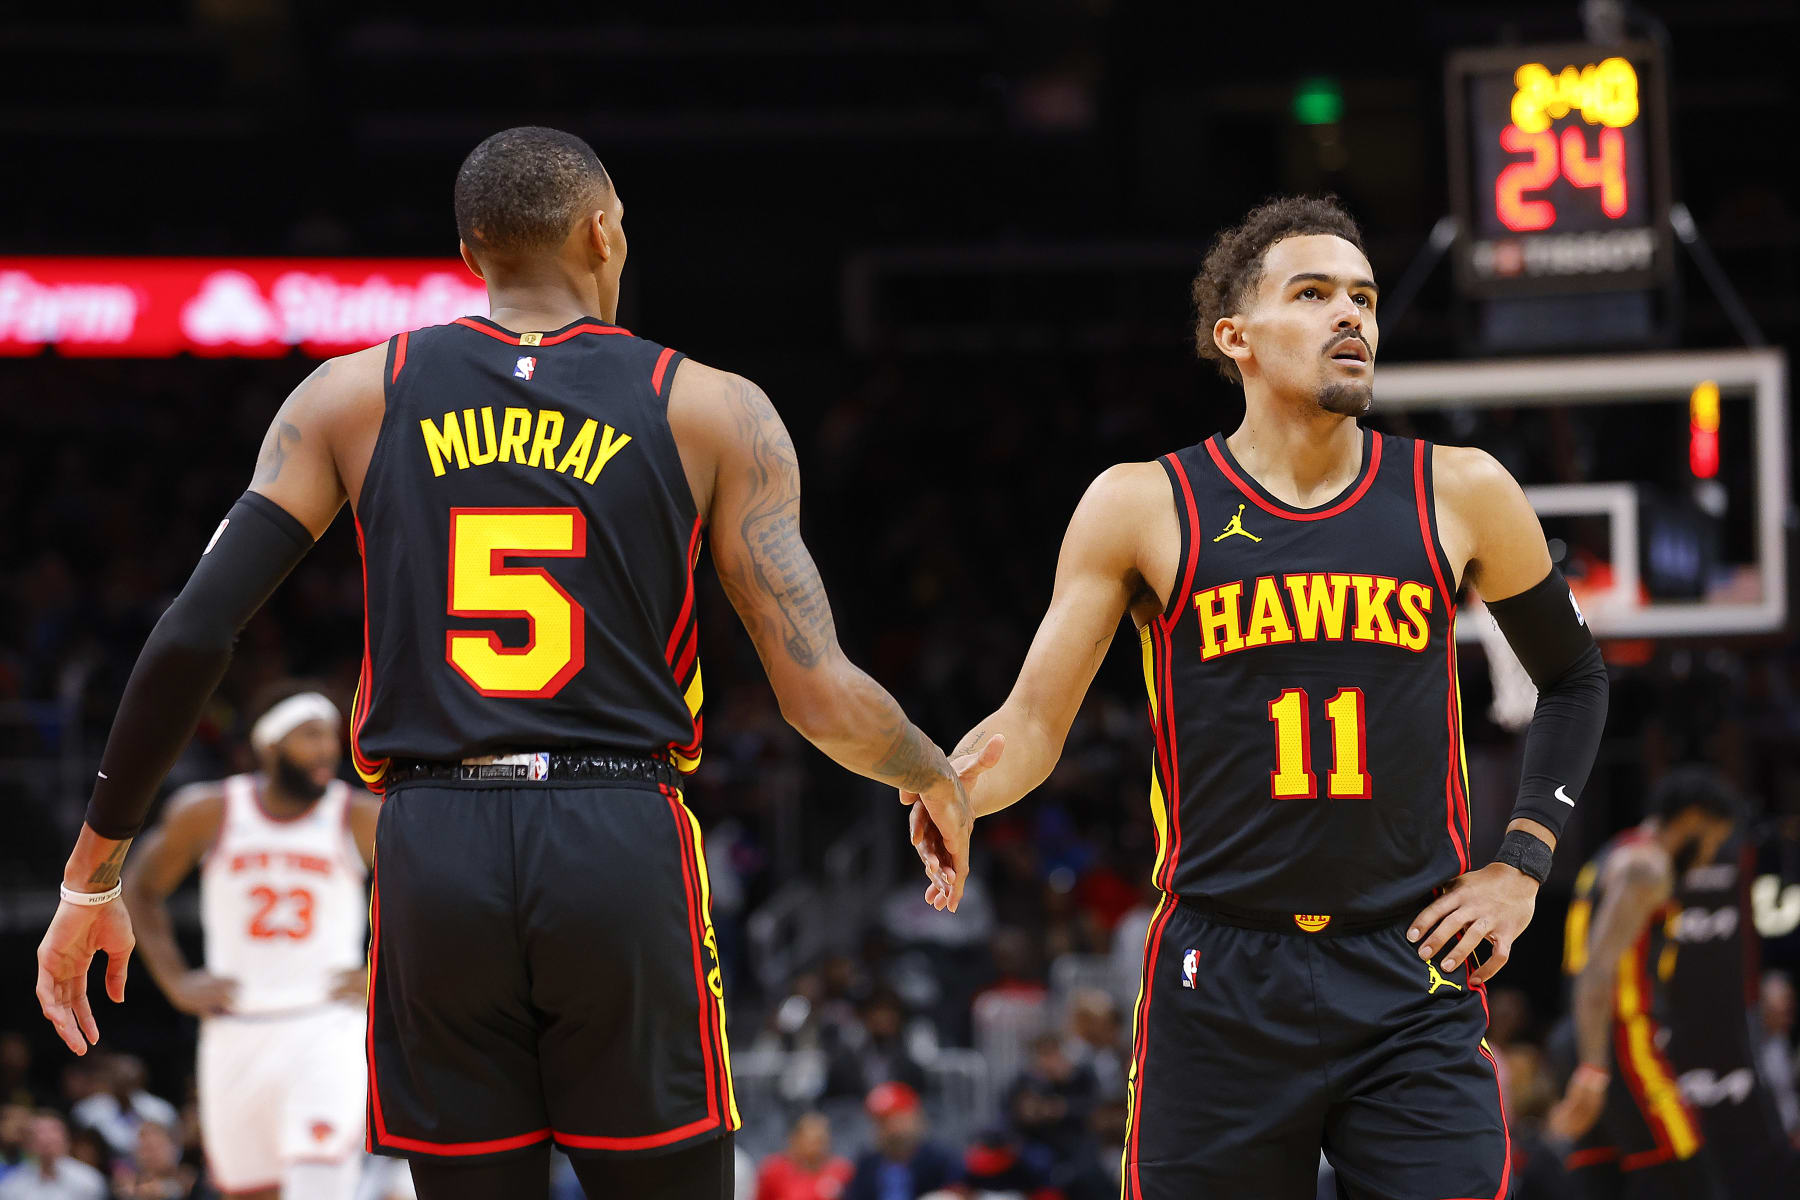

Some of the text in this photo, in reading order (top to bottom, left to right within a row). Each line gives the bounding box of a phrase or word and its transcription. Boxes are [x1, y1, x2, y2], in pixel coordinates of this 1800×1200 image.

[1496, 123, 1627, 232] 24
[420, 406, 632, 485] MURRAY
[445, 507, 587, 699] 5
[1192, 573, 1433, 663] HAWKS
[1267, 687, 1373, 799] 11
[248, 882, 316, 941] 23
